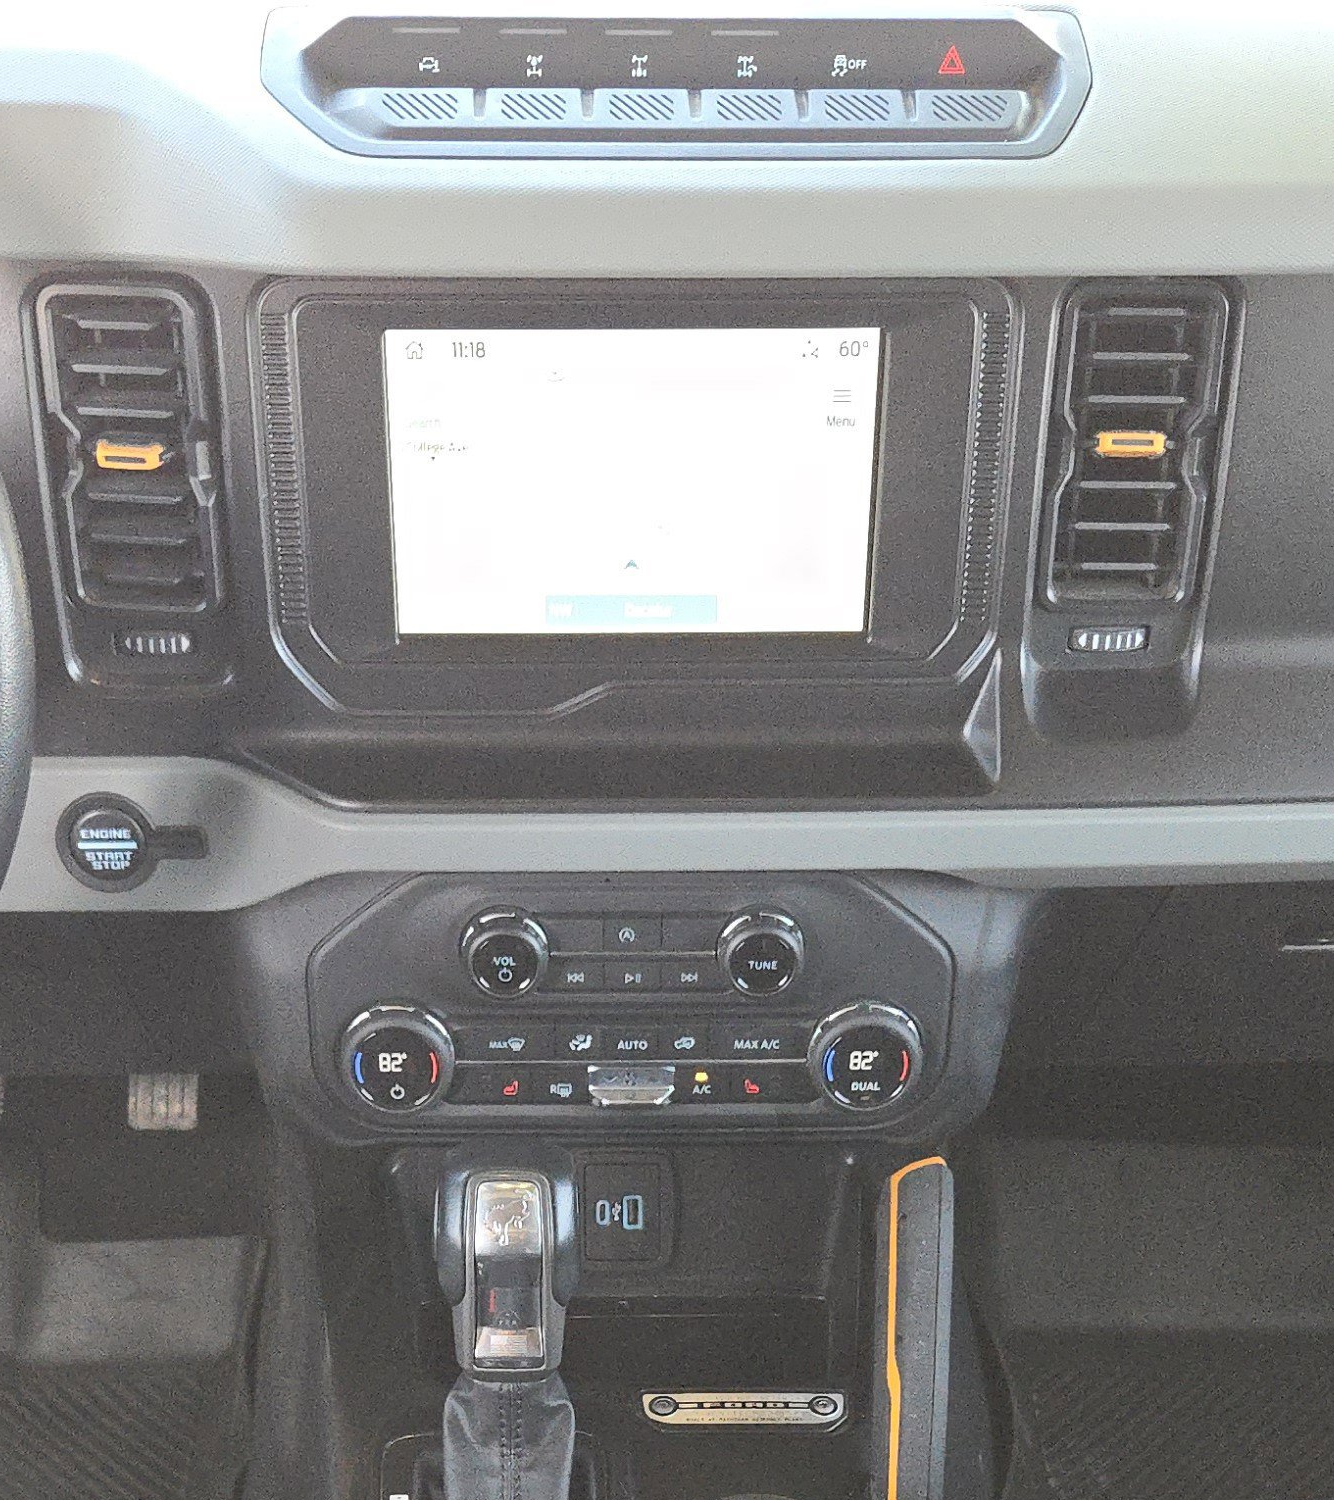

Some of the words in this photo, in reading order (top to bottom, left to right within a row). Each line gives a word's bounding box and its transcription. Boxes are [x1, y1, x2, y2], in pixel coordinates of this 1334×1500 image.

[847, 58, 867, 70] OFF
[452, 341, 486, 358] 11:18
[827, 415, 855, 427] Menu
[79, 829, 131, 840] ENGINE
[85, 851, 133, 861] START
[92, 860, 130, 870] STOP
[493, 957, 516, 967] VOL
[748, 960, 778, 971] TUNE
[488, 1040, 509, 1049] MAX
[617, 1039, 648, 1051] AUTO
[733, 1039, 758, 1050] MAX
[760, 1038, 780, 1050] A/C
[692, 1084, 711, 1095] A/C
[851, 1082, 881, 1092] DUAL
